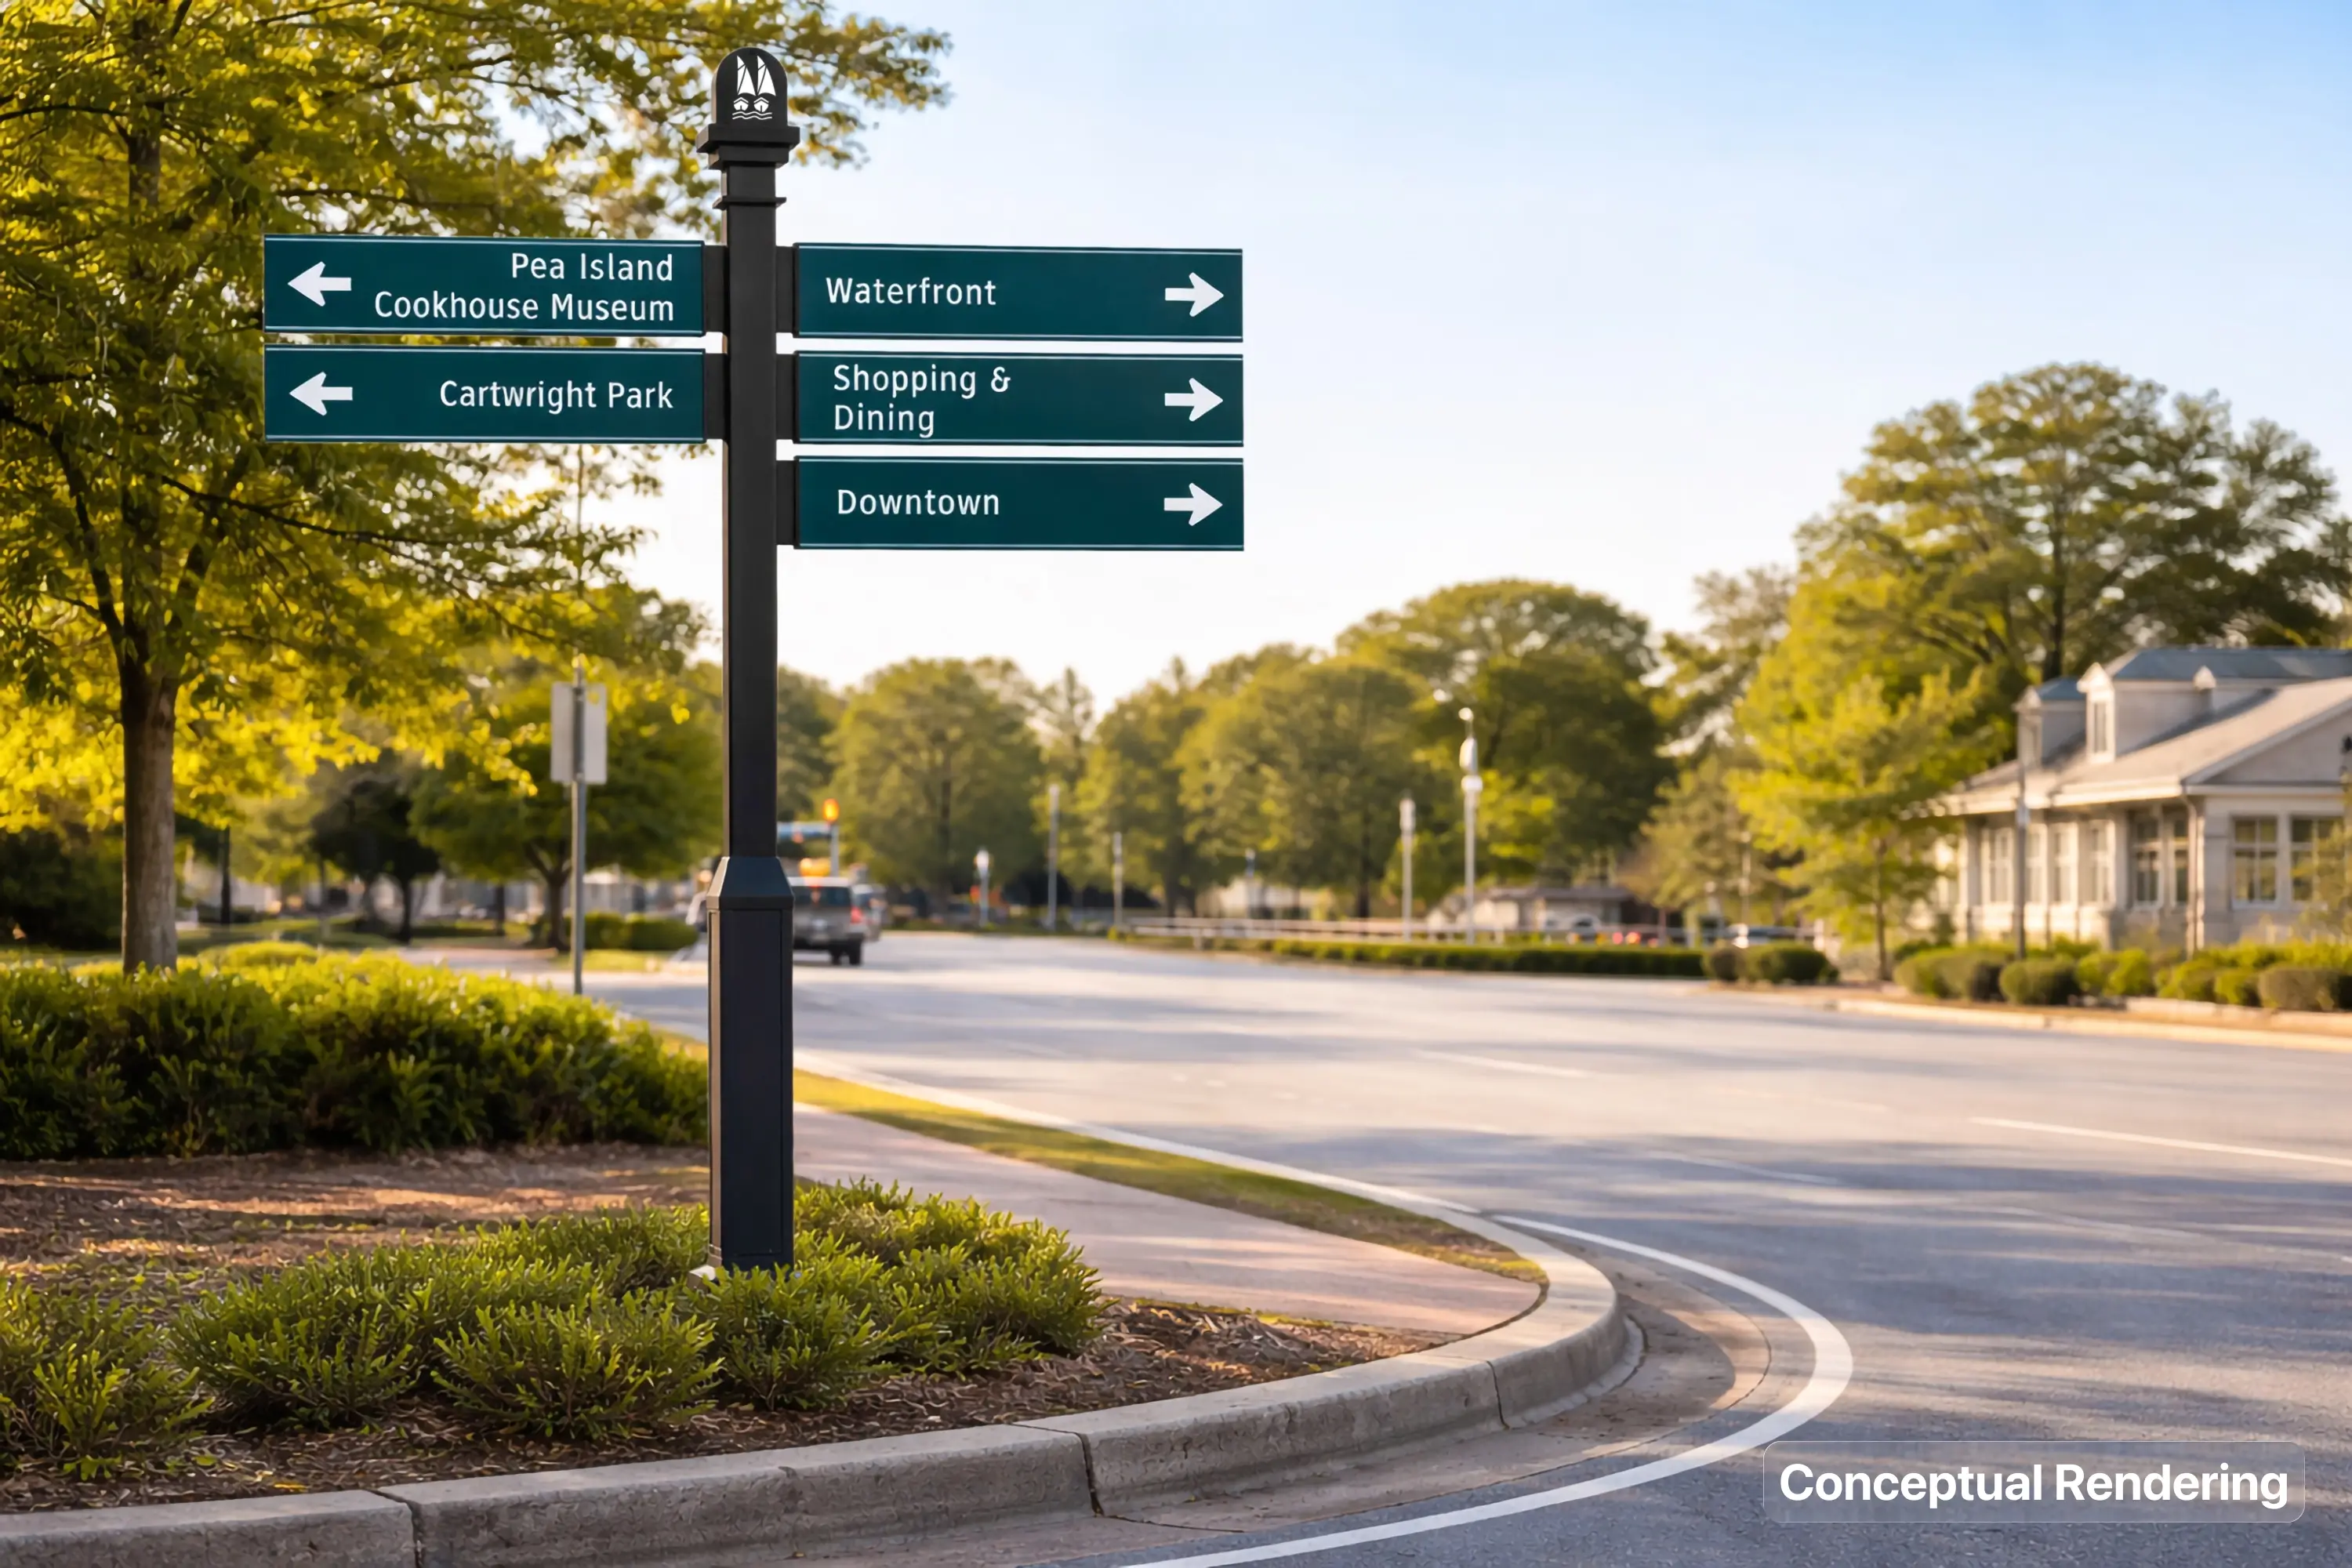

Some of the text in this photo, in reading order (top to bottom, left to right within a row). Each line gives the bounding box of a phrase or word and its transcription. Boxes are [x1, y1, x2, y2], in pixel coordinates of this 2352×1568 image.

[512, 252, 673, 281] Pea Island
[375, 290, 673, 321] Cookhouse Museum
[826, 277, 996, 305] Waterfront
[833, 364, 1011, 399] Shopping &
[440, 380, 673, 415] Cartwright Park
[835, 402, 935, 438] Dining
[838, 489, 999, 515] Downtown
